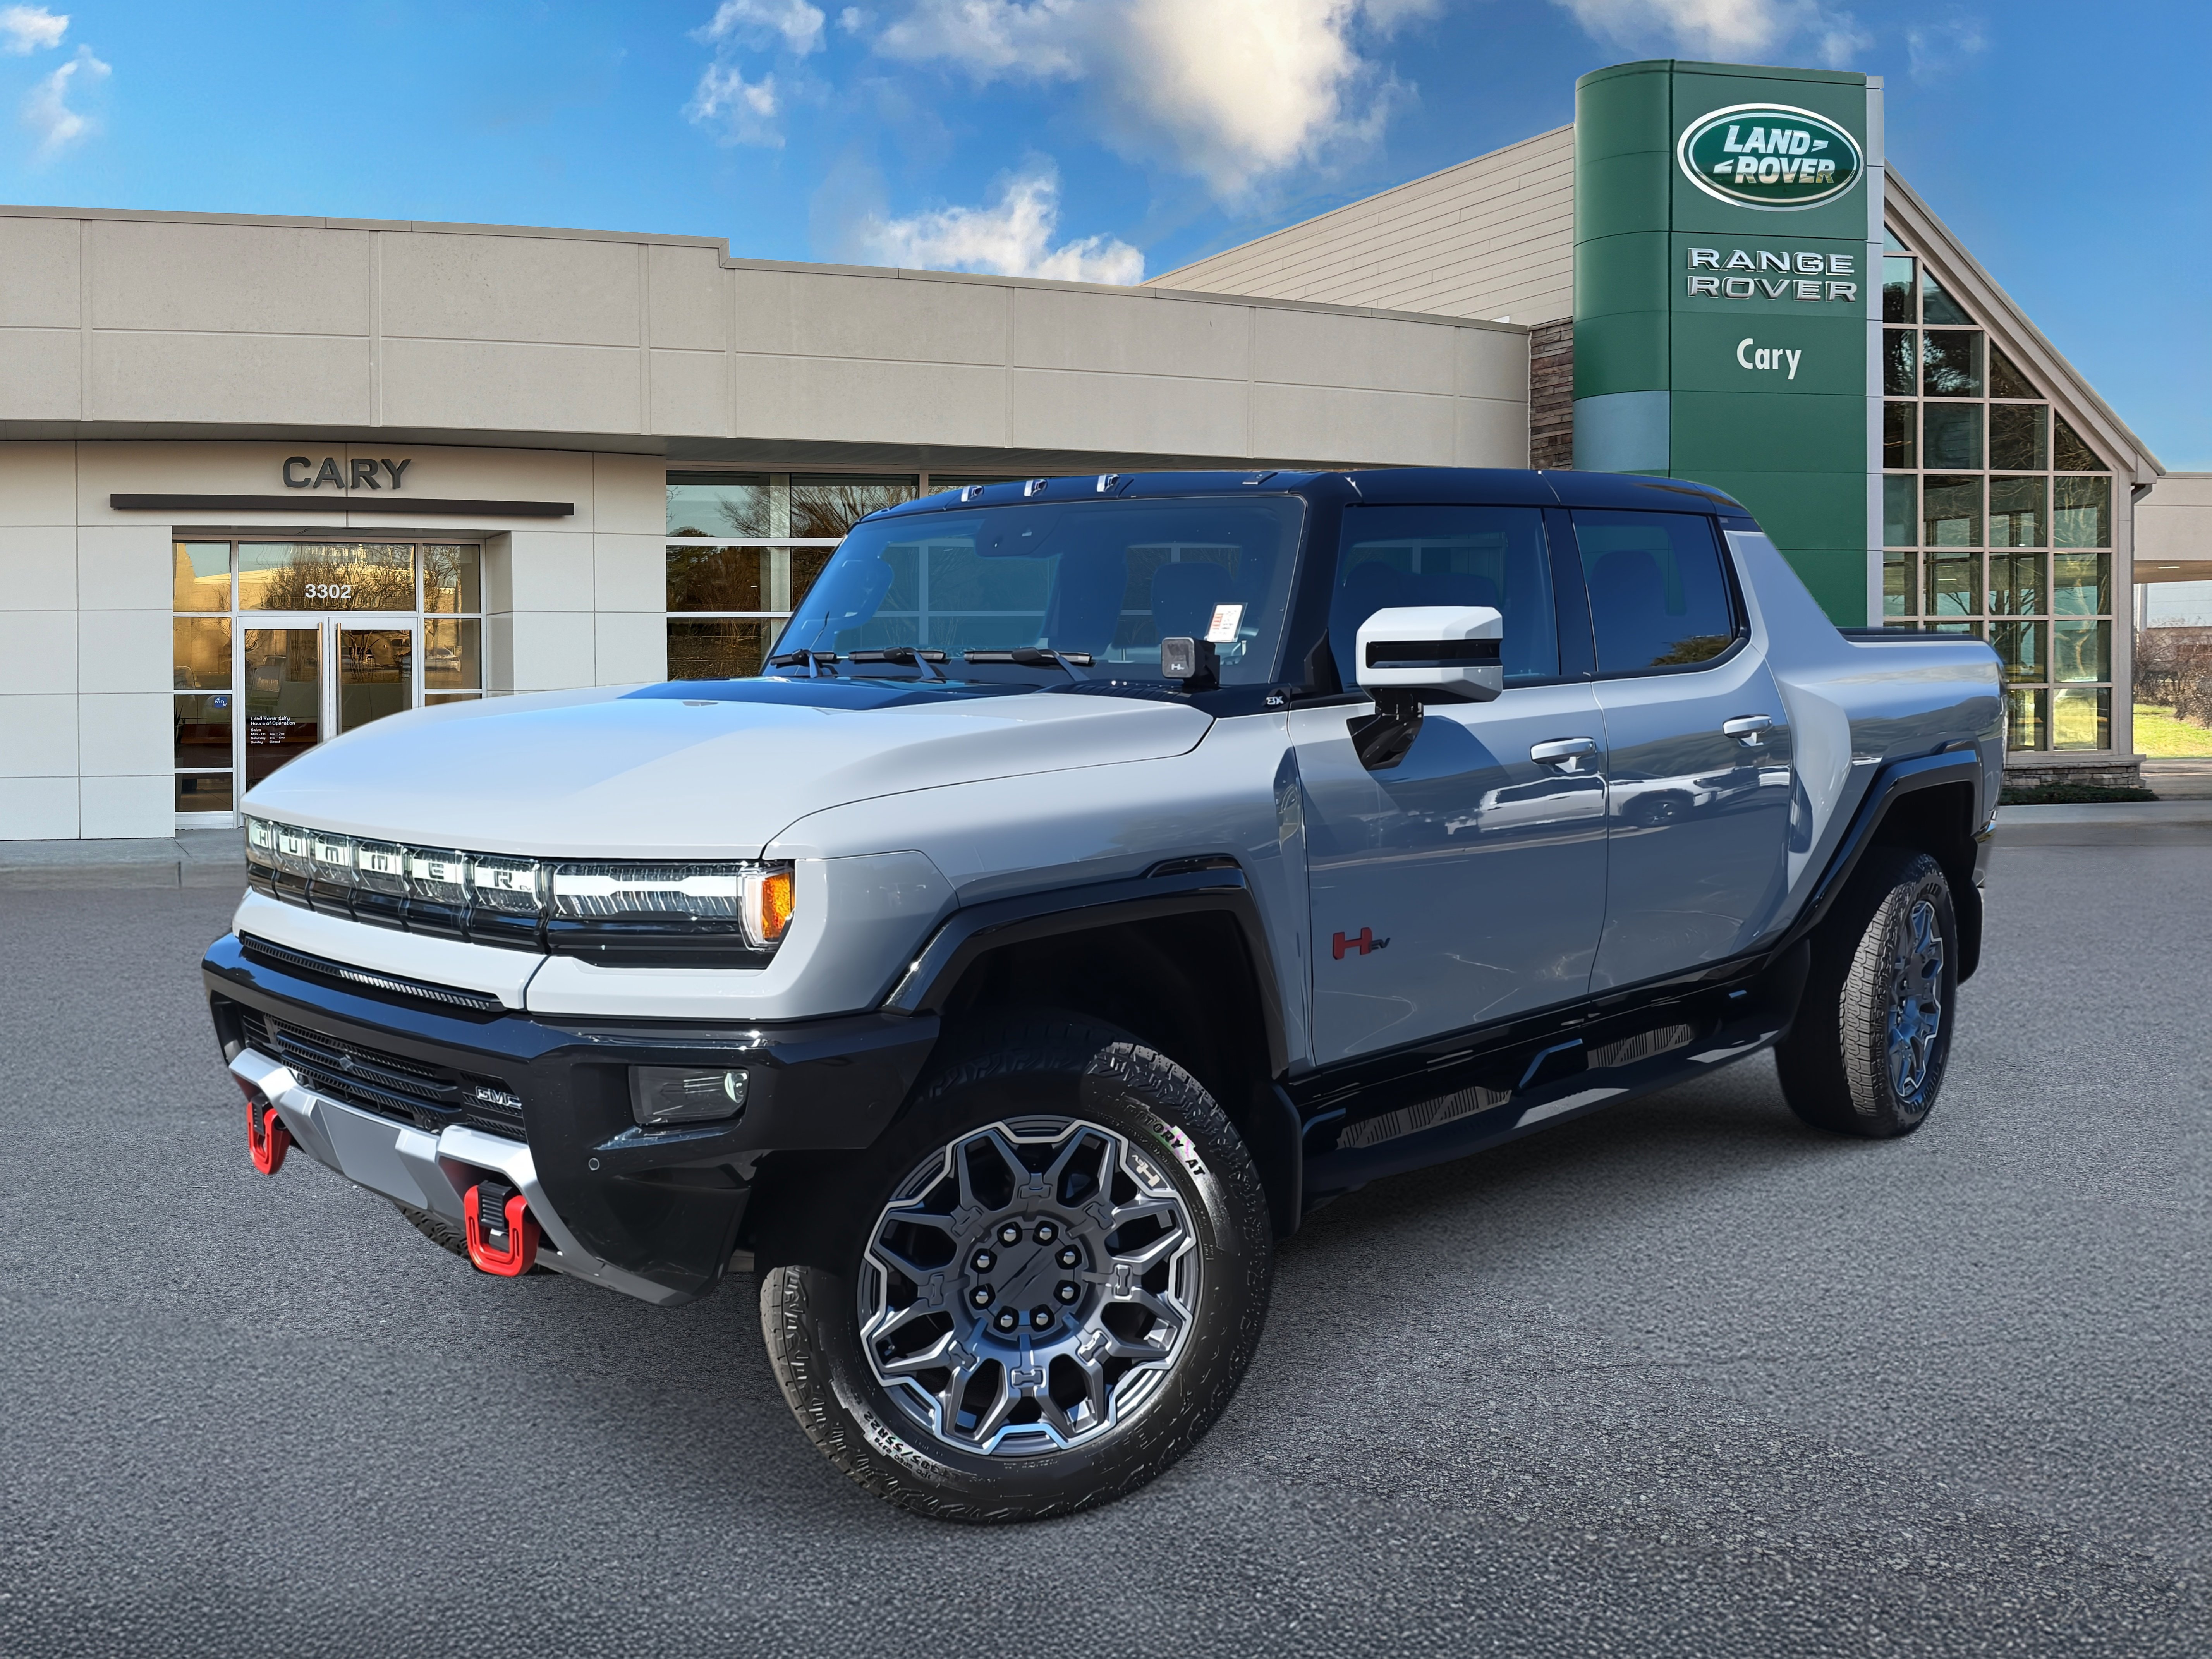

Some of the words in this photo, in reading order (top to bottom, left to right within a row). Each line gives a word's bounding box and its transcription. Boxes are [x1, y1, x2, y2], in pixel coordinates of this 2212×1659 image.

[1723, 125, 1810, 155] LAND
[1735, 156, 1836, 184] ROVER
[1688, 248, 1855, 275] RANGE
[1688, 276, 1857, 303] ROVER
[1737, 338, 1802, 380] Cary
[283, 456, 412, 489] CARY
[305, 584, 351, 598] 3302
[258, 830, 512, 889] HUMMER
[476, 1086, 522, 1110] GMC
[1185, 1159, 1206, 1175] AT
